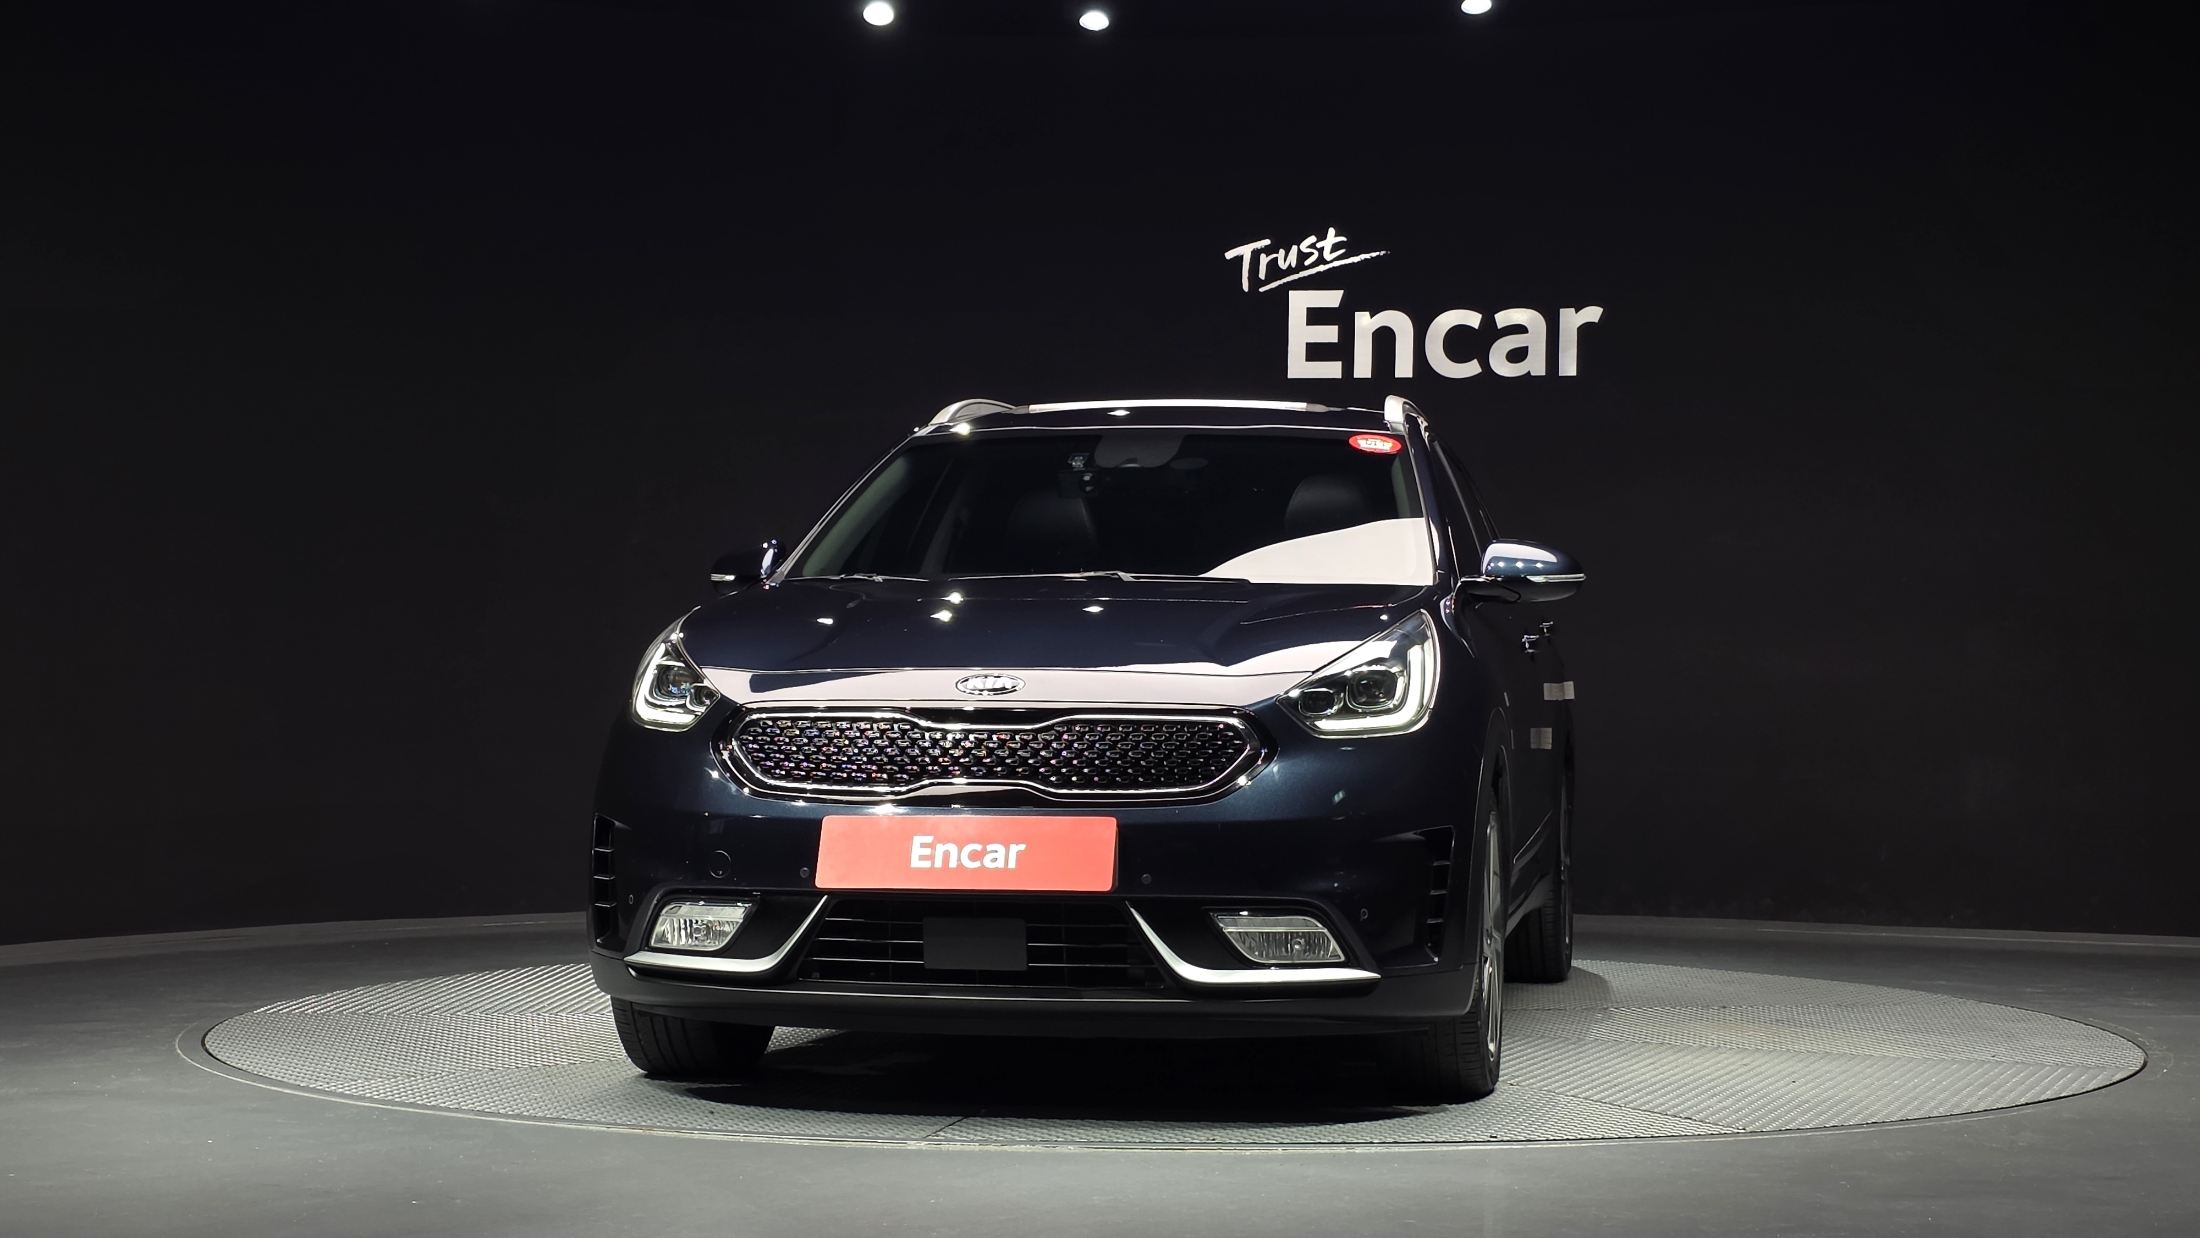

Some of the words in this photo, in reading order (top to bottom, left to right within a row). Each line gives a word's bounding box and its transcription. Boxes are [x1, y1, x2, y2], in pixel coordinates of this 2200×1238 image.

[1225, 227, 1348, 292] Trust
[1287, 289, 1604, 379] Encar
[909, 835, 1027, 869] Encar
